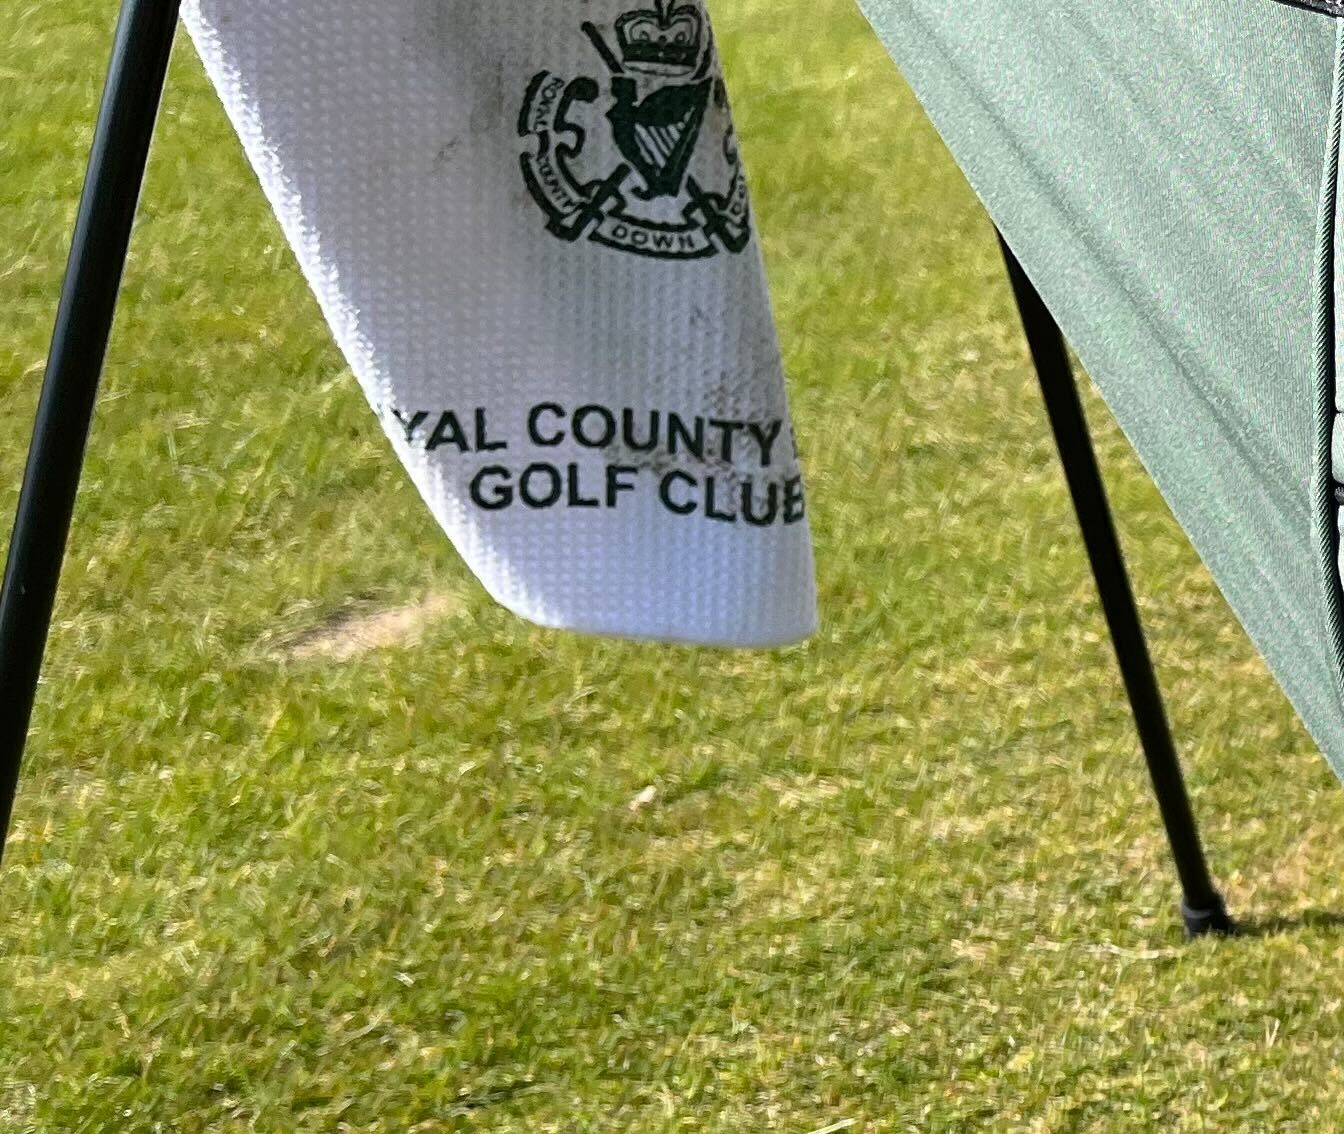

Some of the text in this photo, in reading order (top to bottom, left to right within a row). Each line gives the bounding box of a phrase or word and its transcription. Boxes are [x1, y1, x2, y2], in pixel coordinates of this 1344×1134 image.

[611, 224, 694, 249] DOWN
[527, 402, 782, 467] COUNTY
[469, 462, 805, 526] GOLF CLUB
